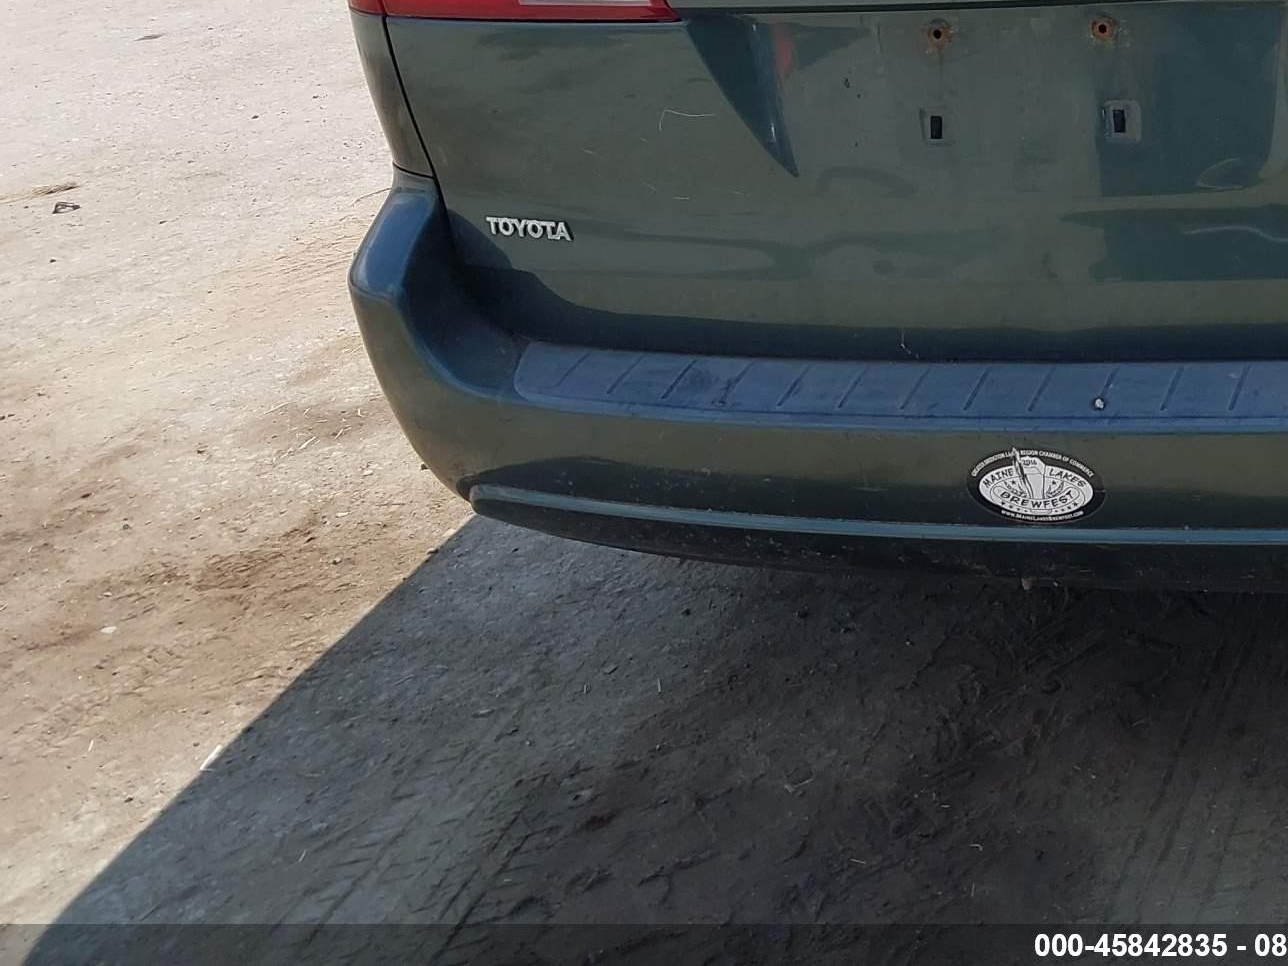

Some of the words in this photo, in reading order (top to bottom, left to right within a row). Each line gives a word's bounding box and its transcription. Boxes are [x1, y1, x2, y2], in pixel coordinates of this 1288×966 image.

[486, 216, 572, 241] TOYOTA
[982, 467, 1014, 488] MAINE
[1049, 468, 1087, 487] LAKES
[1000, 489, 1074, 509] BREWFEST
